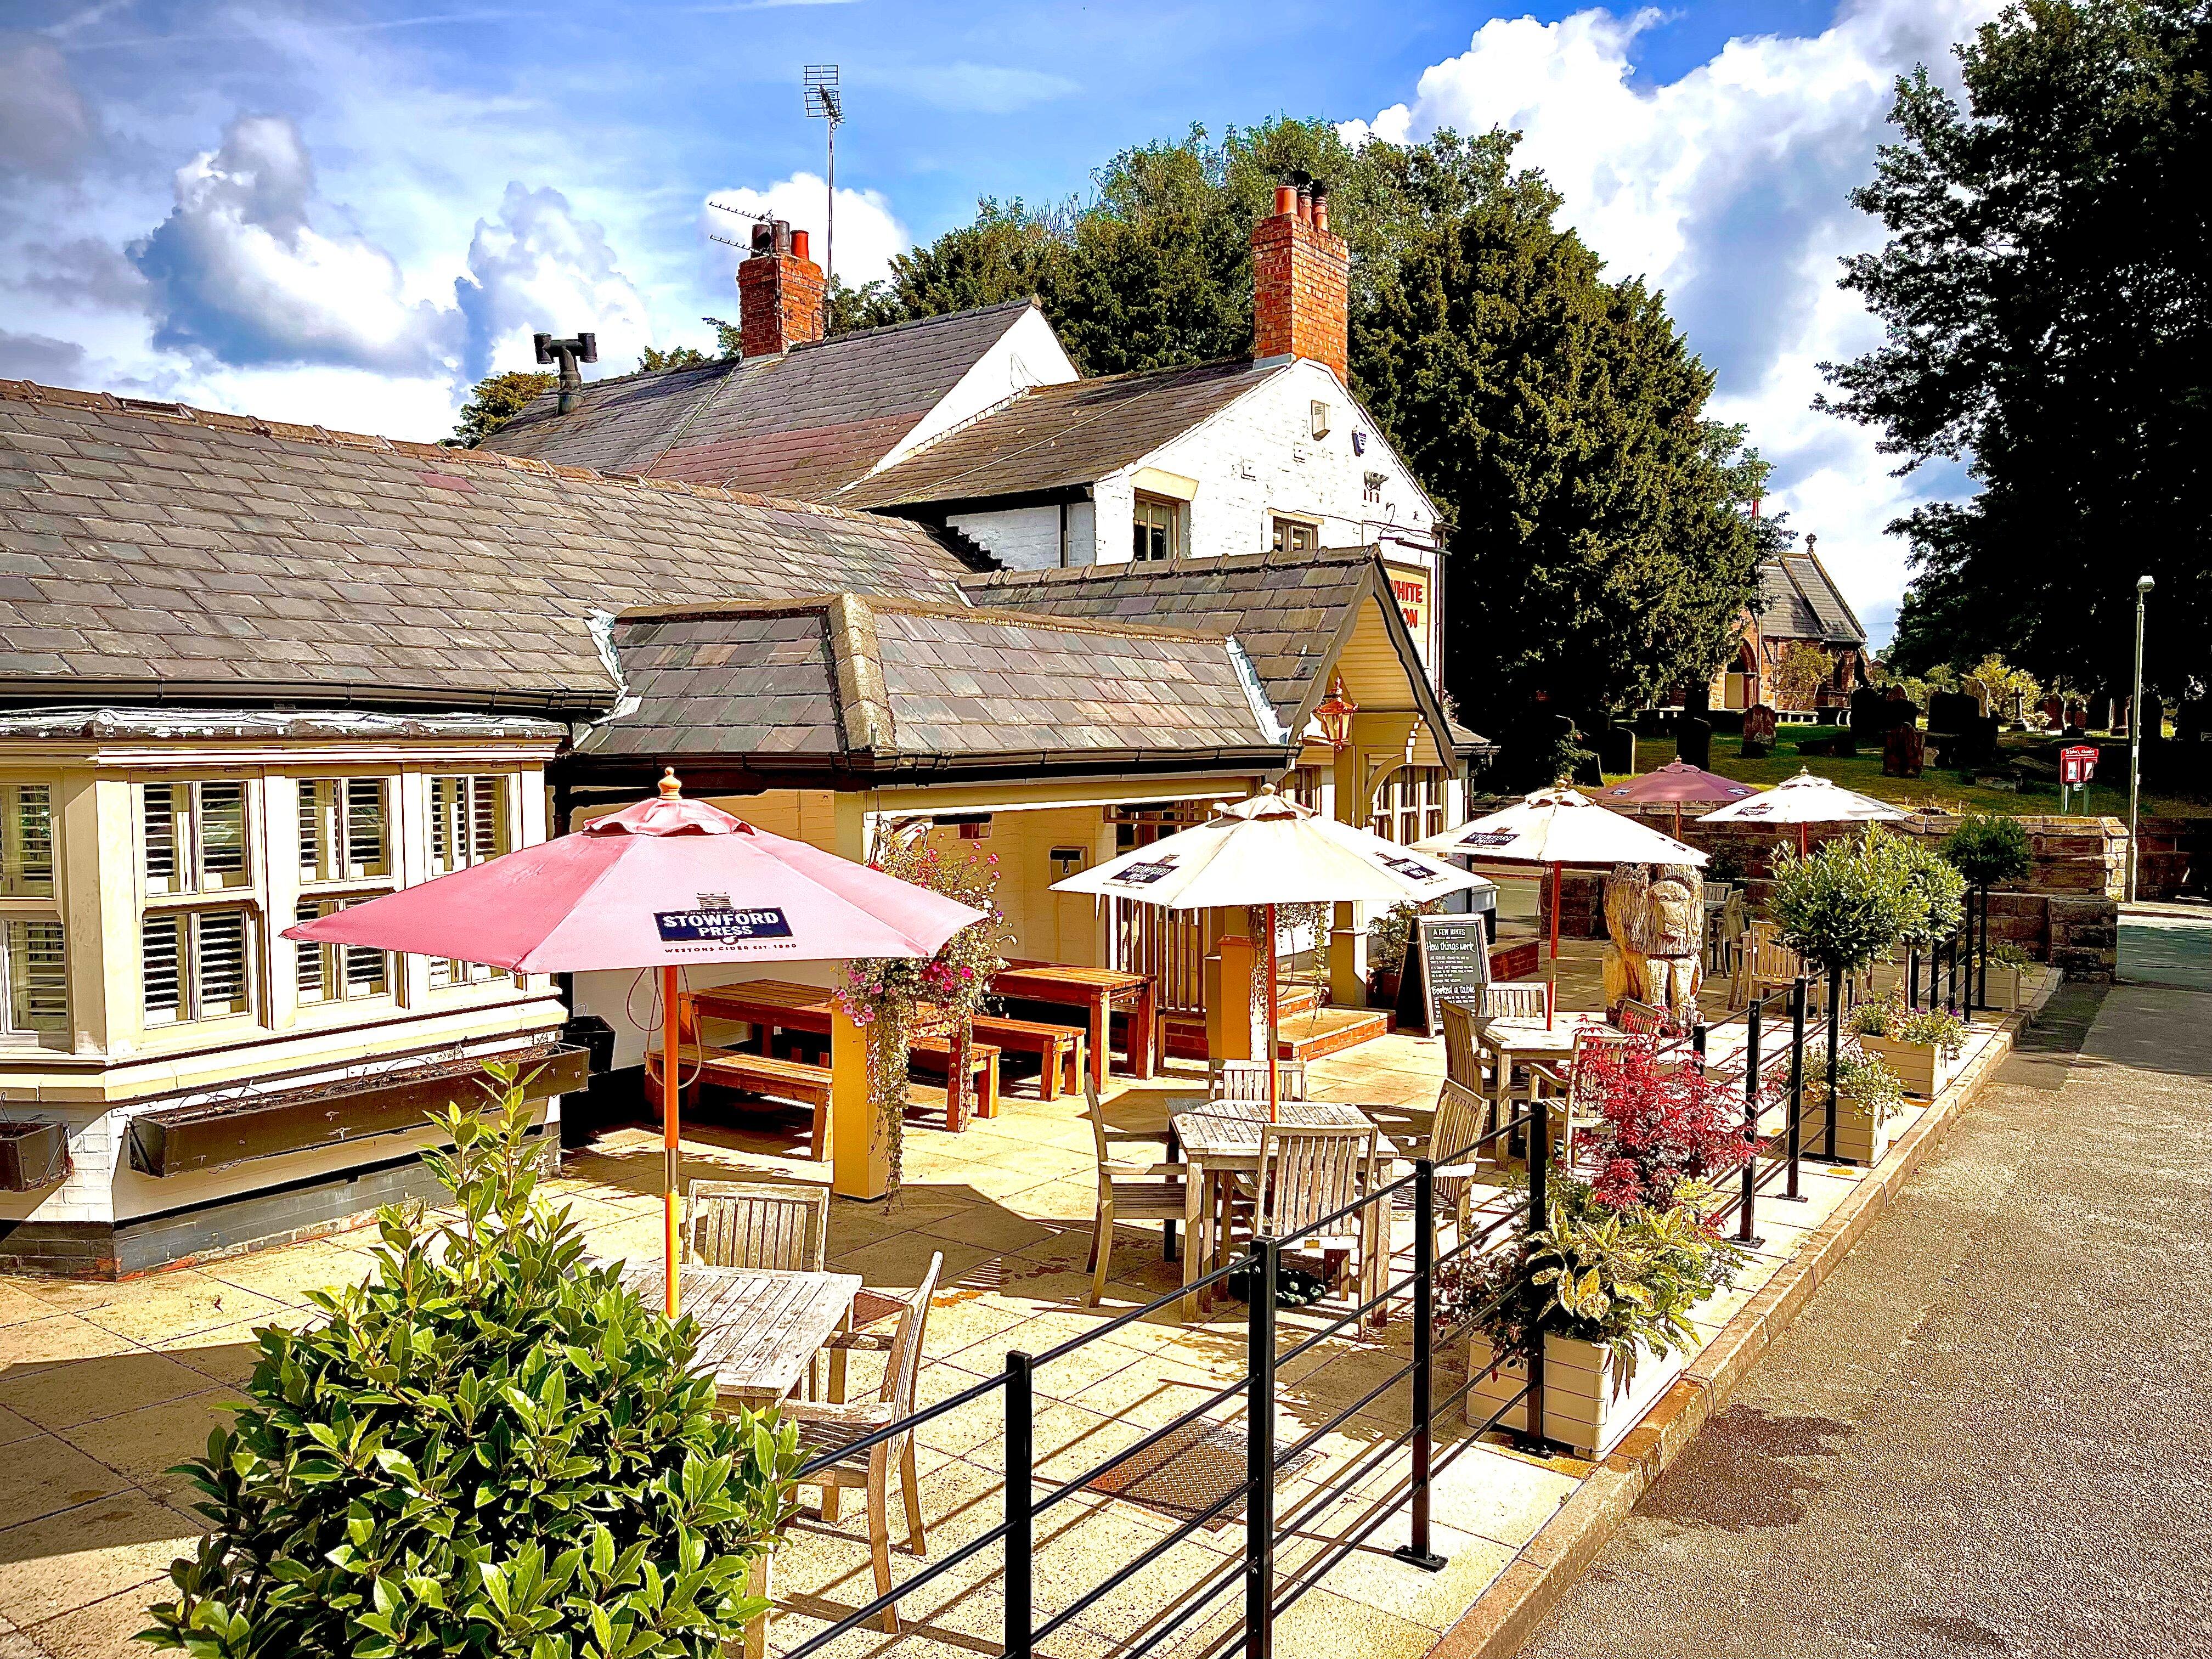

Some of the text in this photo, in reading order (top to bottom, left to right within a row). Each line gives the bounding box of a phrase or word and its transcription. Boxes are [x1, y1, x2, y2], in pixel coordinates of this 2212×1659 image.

[1401, 608, 1418, 629] ON
[663, 912, 779, 927] STOWFORD
[698, 925, 753, 936] PRESS
[1426, 940, 1476, 953] How things work
[1431, 985, 1453, 995] Booked
[1459, 984, 1476, 994] table
